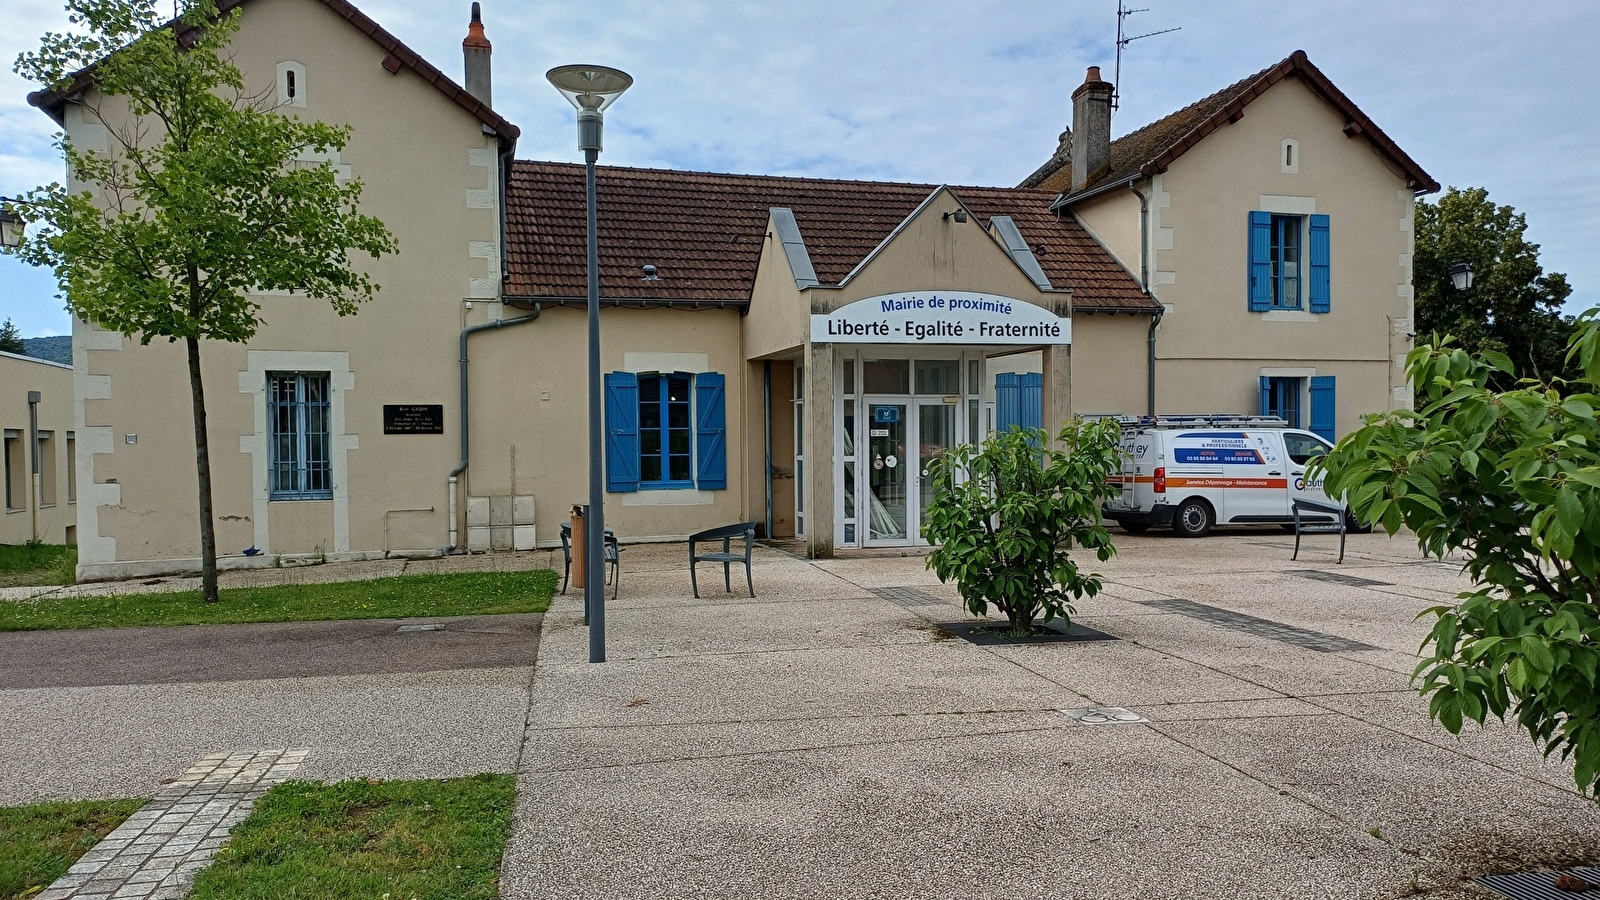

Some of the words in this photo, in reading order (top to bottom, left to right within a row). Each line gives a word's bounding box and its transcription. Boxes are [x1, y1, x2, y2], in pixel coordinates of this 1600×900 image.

[880, 296, 924, 313] Mairie
[928, 295, 945, 308] de
[949, 297, 1012, 315] proximité
[828, 319, 889, 336] Liberté
[905, 320, 963, 339] Egalité
[980, 321, 1060, 337] Fraternité
